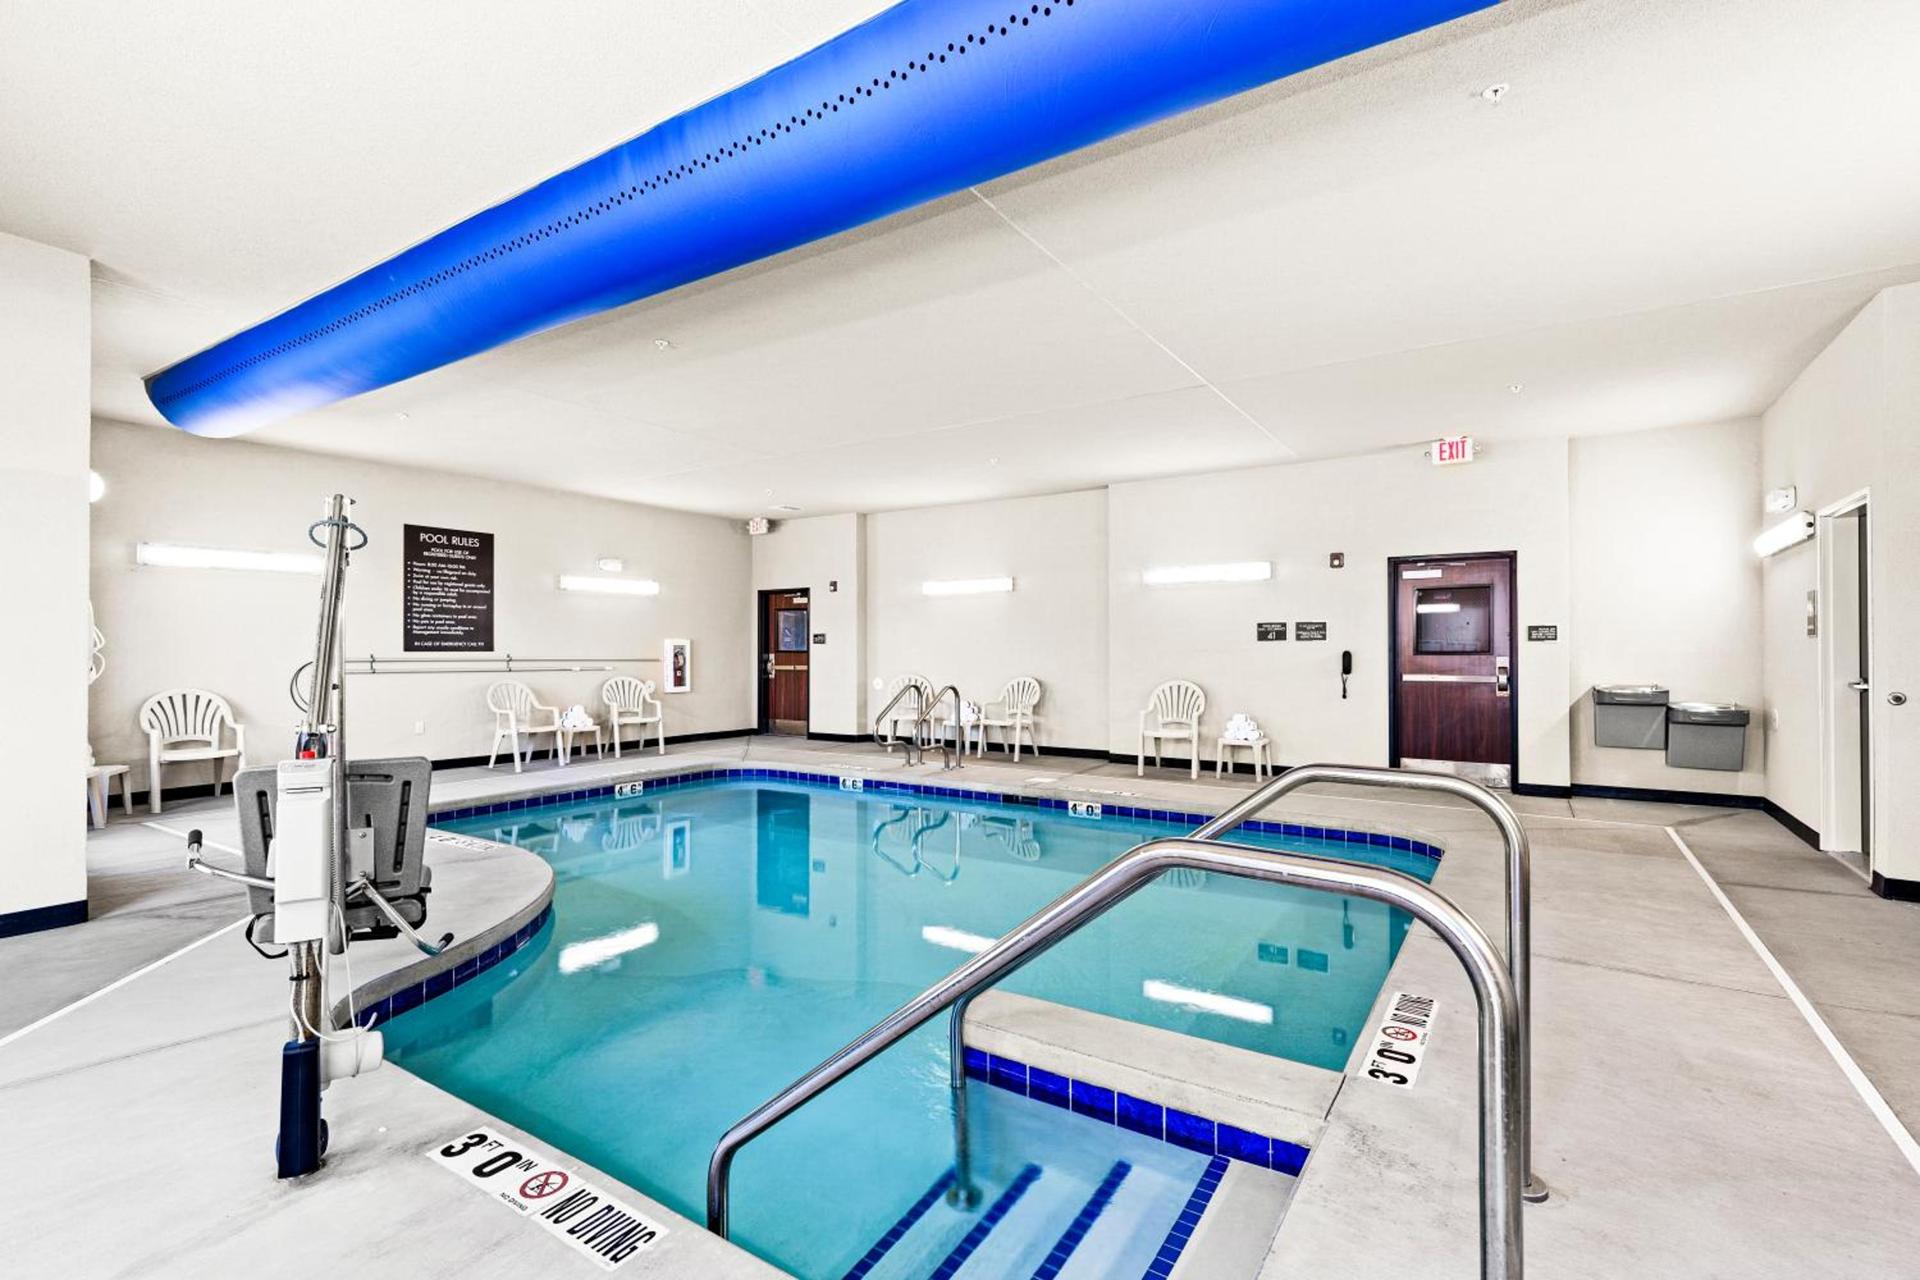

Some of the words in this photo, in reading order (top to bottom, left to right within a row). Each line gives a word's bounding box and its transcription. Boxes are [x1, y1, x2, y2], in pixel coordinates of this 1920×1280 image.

[1439, 440, 1467, 461] EXIT
[420, 533, 449, 545] POOL
[451, 536, 480, 548] RULES
[1267, 631, 1276, 640] 41
[1070, 803, 1078, 815] 4
[1377, 1048, 1416, 1064] 0
[1368, 1068, 1408, 1085] 3
[440, 1133, 488, 1158] 3
[481, 1140, 504, 1152] FT
[472, 1151, 523, 1178] 0
[515, 1159, 538, 1172] IN
[499, 1191, 511, 1200] NO
[508, 1198, 529, 1211] DIVING
[540, 1188, 599, 1224] NO
[566, 1204, 657, 1264] DIVING
